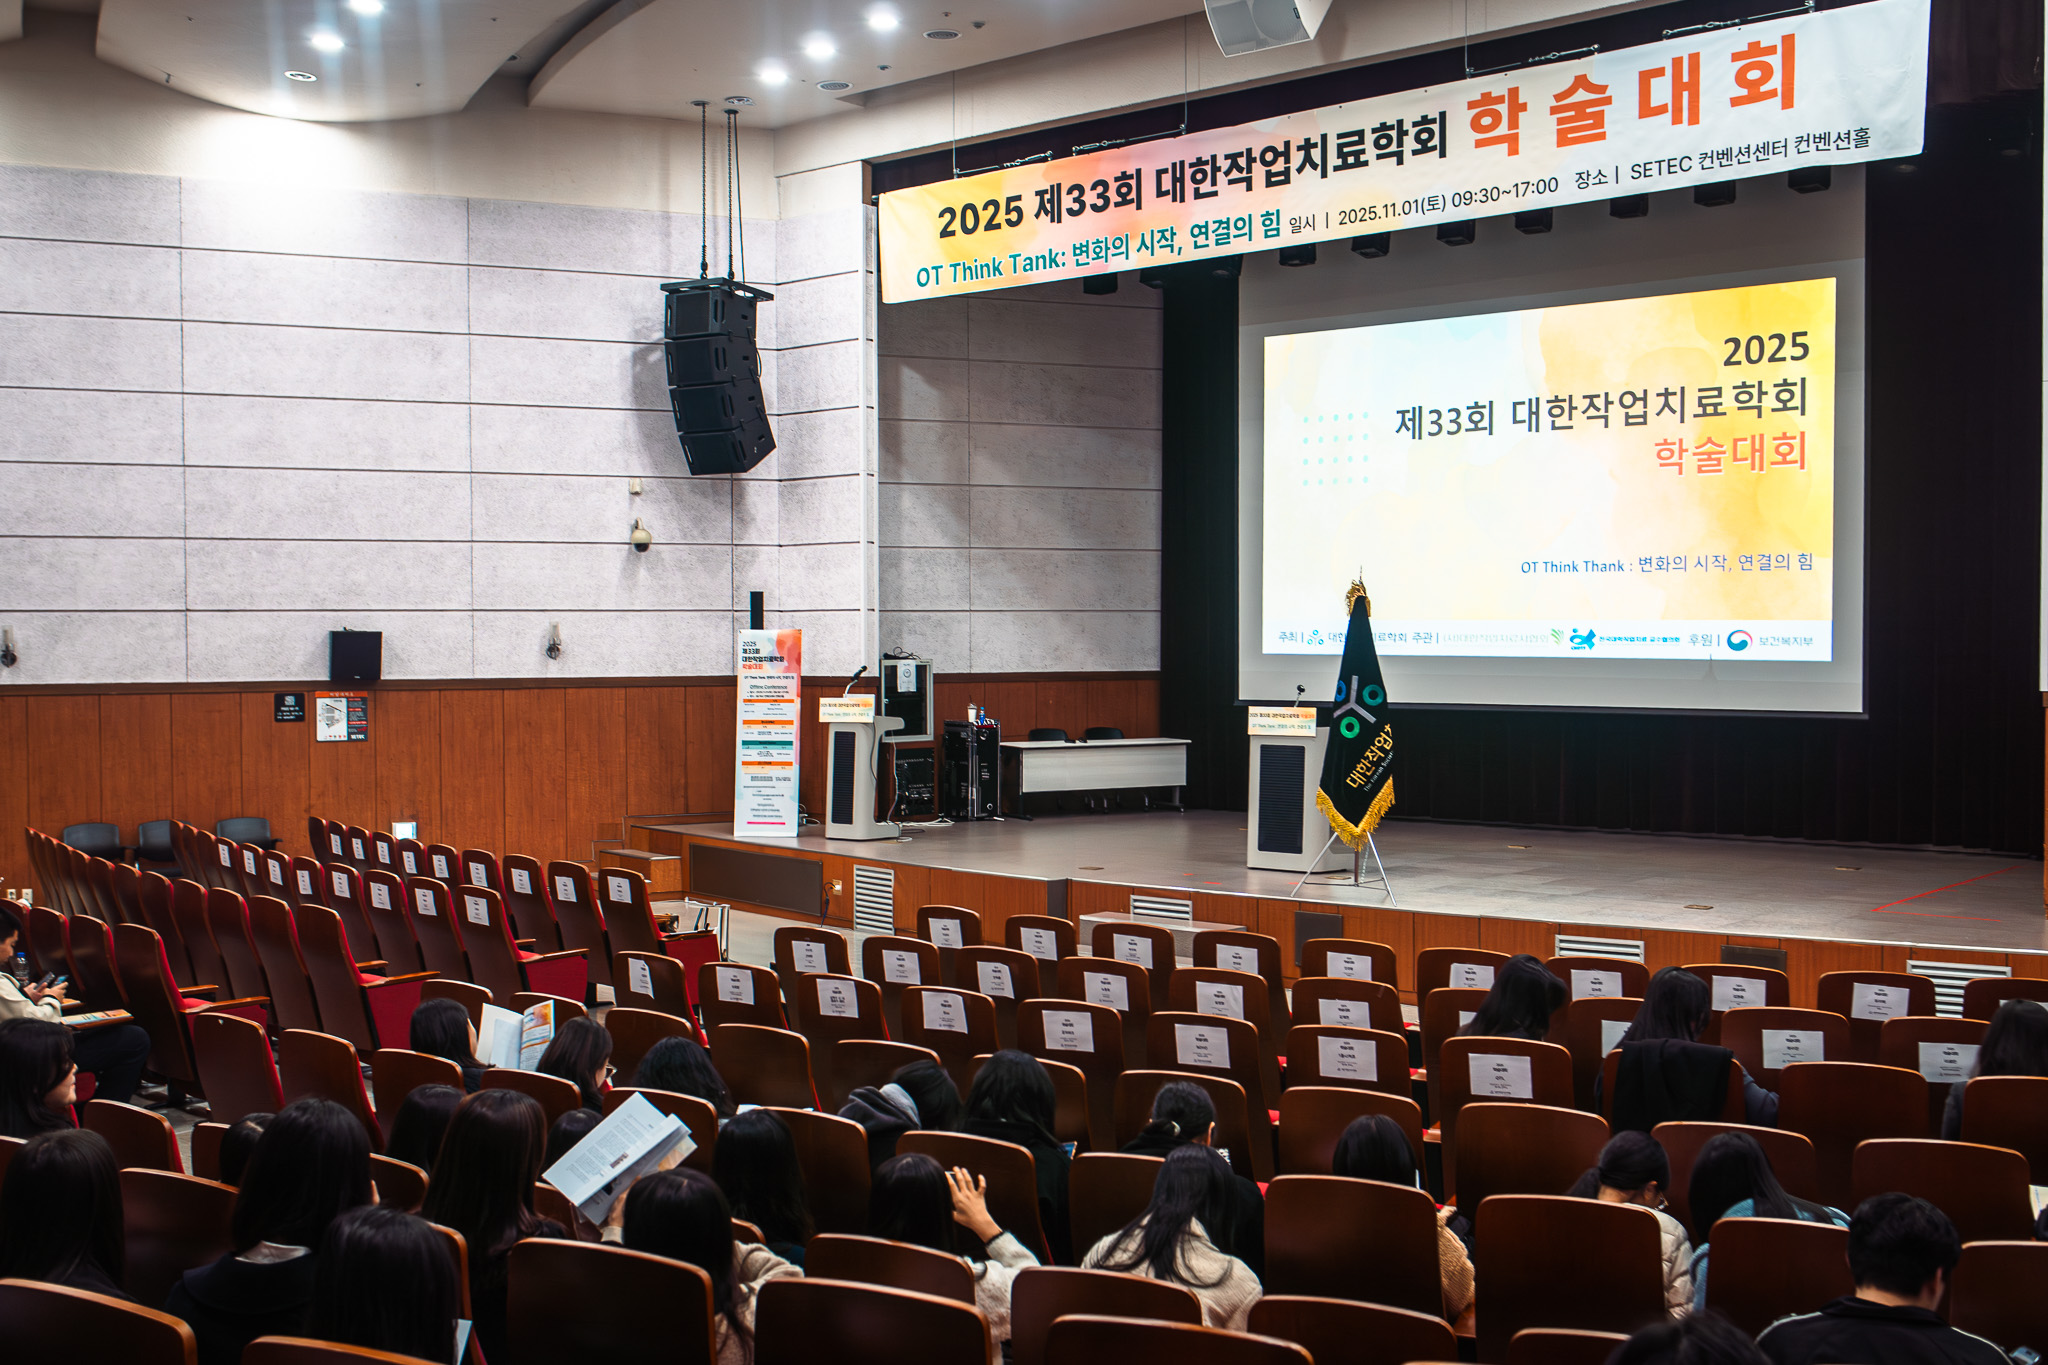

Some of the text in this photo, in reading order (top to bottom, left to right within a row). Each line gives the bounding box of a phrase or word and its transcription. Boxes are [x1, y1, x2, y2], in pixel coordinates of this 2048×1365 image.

[938, 196, 1024, 240] 2025
[1034, 168, 1143, 225] 제33회
[1155, 110, 1448, 204] 대한작업치료학회
[916, 127, 1871, 288] OT Think Tank: 변화의 시작, 연결의 힘 일시 2025.11.01(토) 09:30~17:00 장소 SETEC 컨벤션센터 컨벤션홀
[1722, 331, 1810, 367] 2025
[1395, 376, 1808, 441] 제33회 대한작업치료학회
[1654, 431, 1808, 477] 학술대회
[1520, 561, 1539, 574] OT
[1542, 560, 1579, 573] Think
[1583, 559, 1625, 573] Thank
[1638, 554, 1688, 574] 변화의
[1693, 553, 1733, 574] 시작,
[1738, 553, 1791, 573] 연결의
[1797, 552, 1814, 572] 힘
[1278, 631, 1298, 643] 주최
[1688, 633, 1713, 647] 후원
[1759, 636, 1814, 647] 보건복지부
